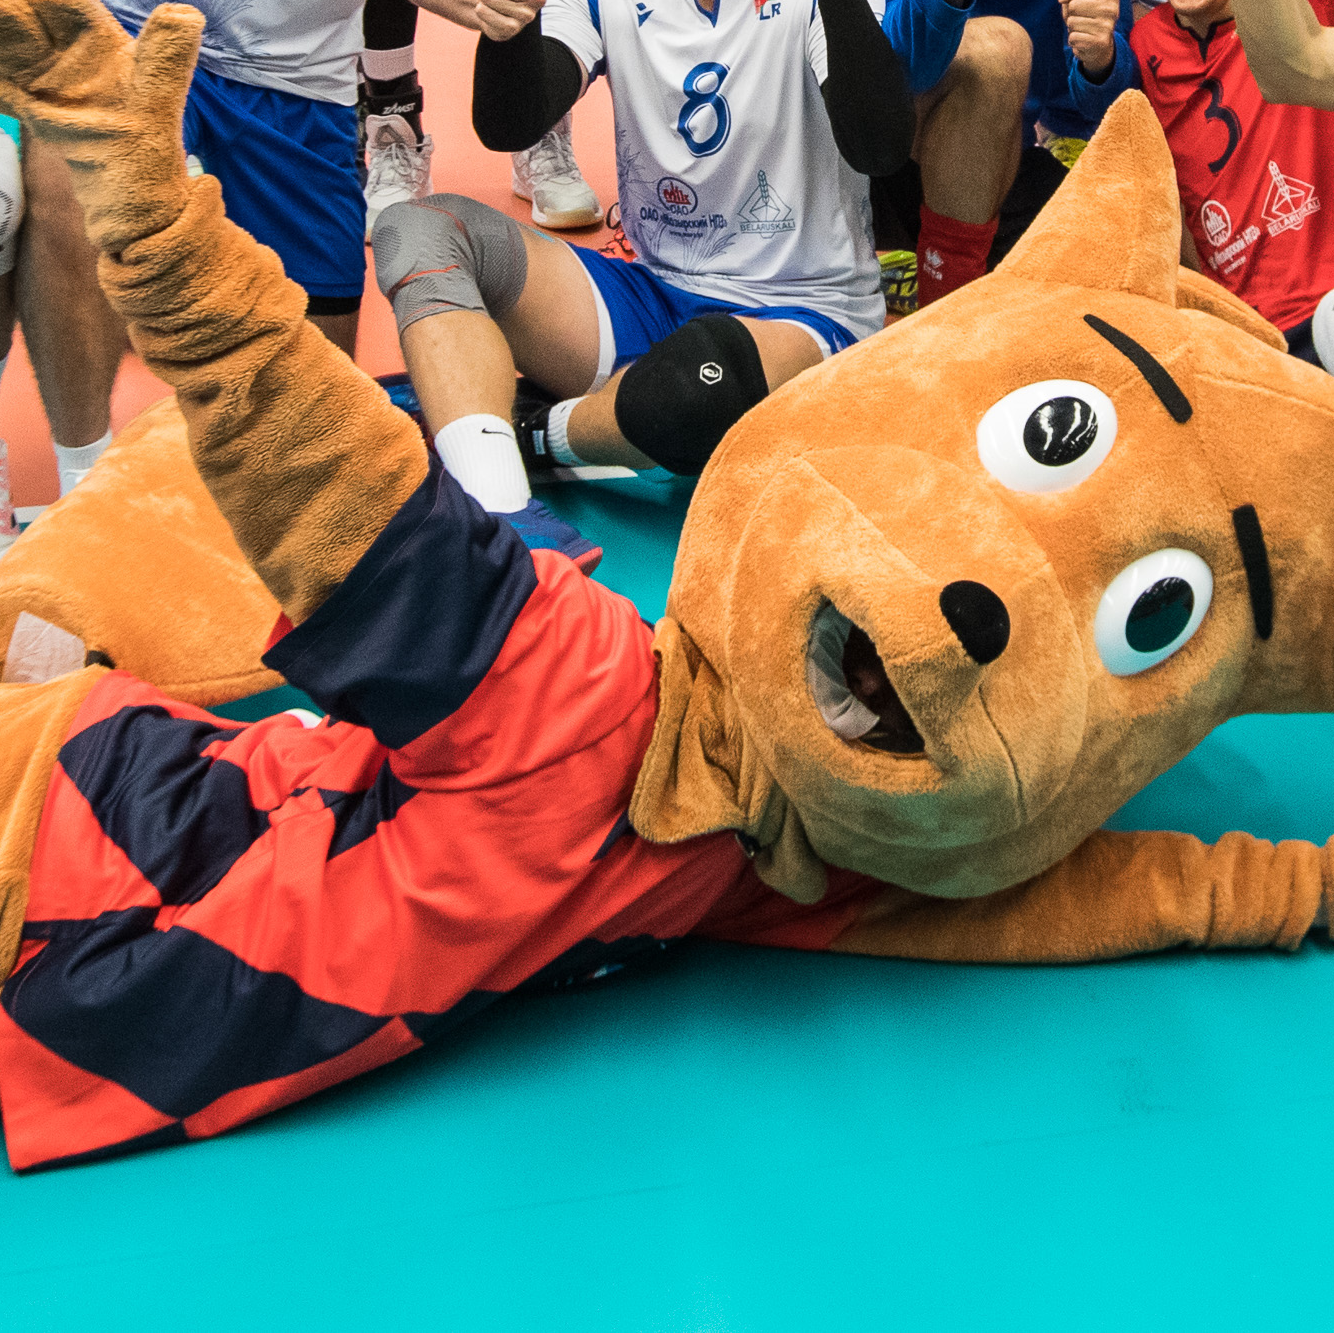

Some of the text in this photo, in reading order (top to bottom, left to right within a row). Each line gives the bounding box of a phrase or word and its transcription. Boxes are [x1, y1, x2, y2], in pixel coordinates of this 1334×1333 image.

[758, 2, 781, 21] LR
[677, 61, 731, 159] 8
[1199, 78, 1243, 175] 3
